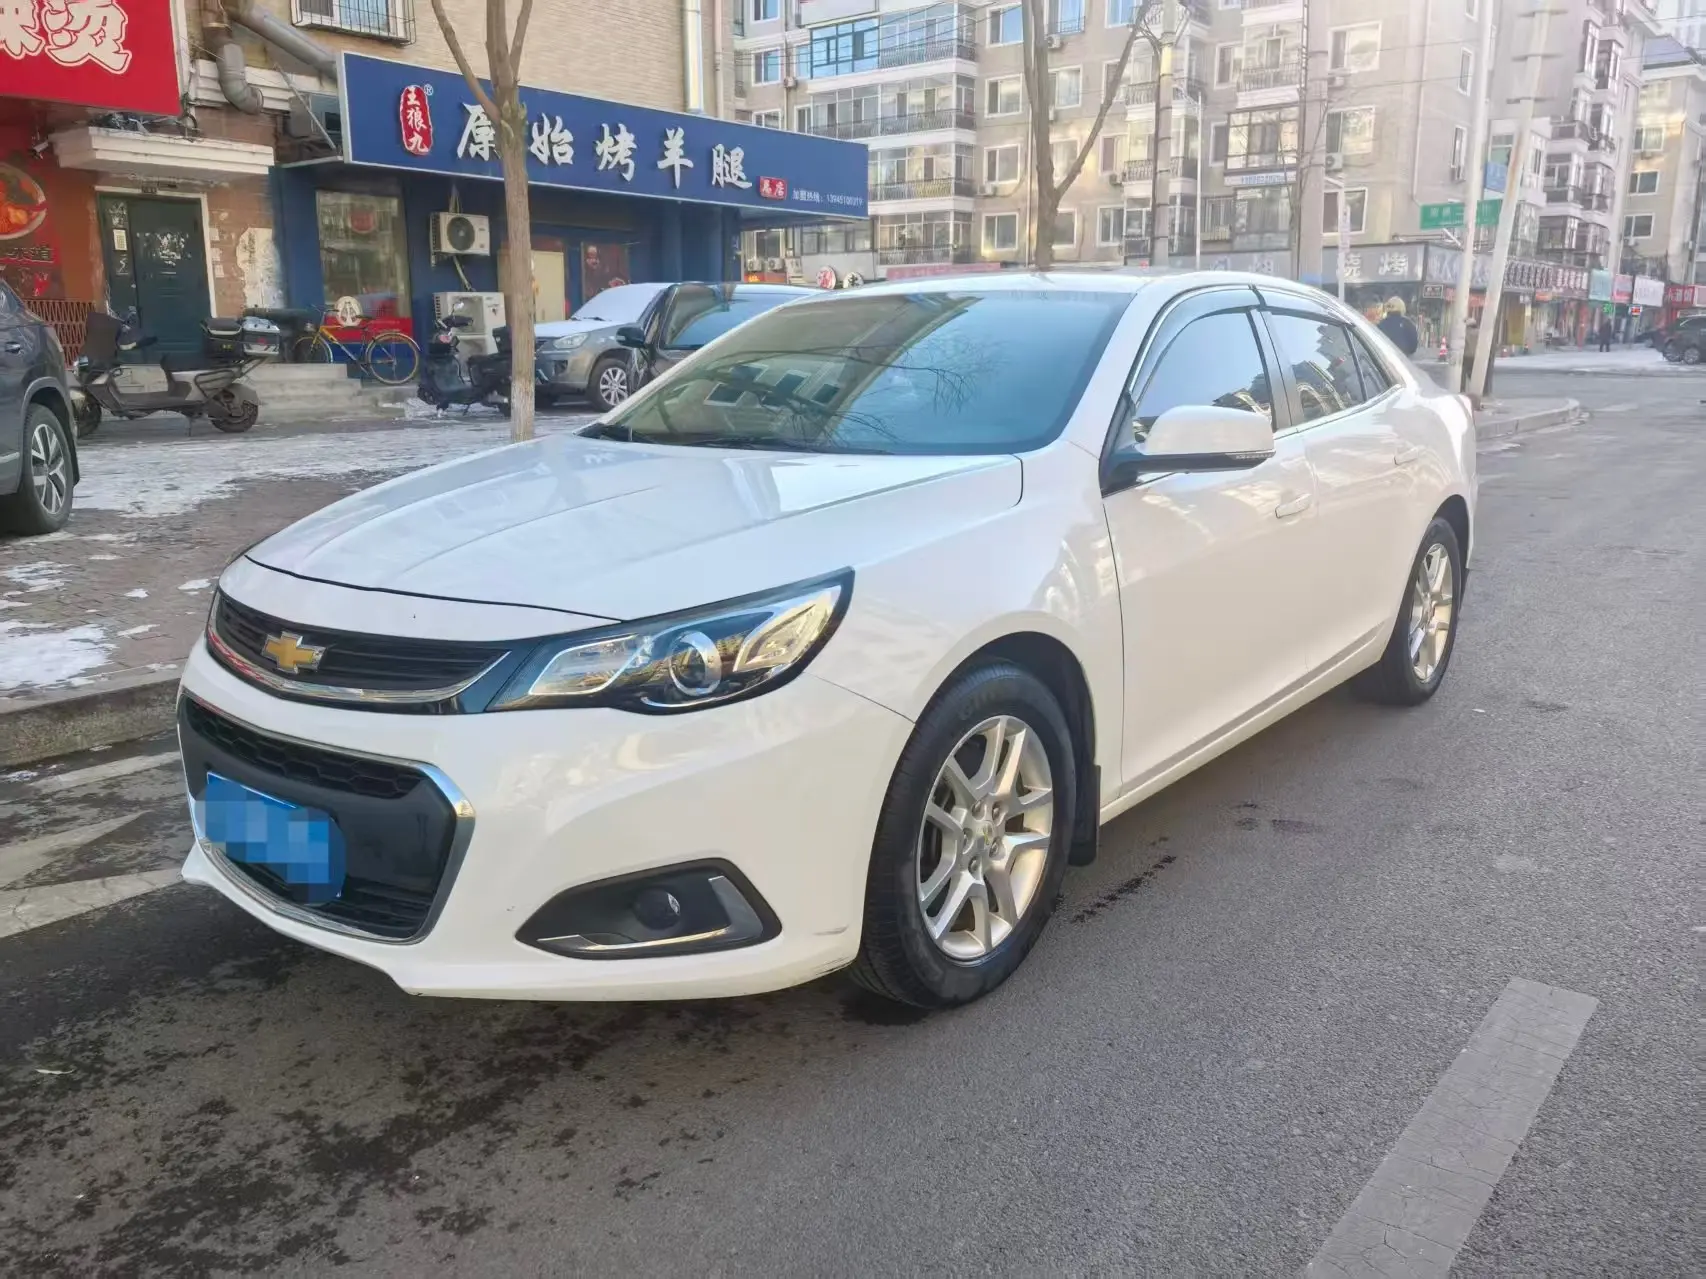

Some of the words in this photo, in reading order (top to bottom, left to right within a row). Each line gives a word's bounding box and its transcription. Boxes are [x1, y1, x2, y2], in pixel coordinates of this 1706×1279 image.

[457, 102, 752, 189] 原始烤羊腿
